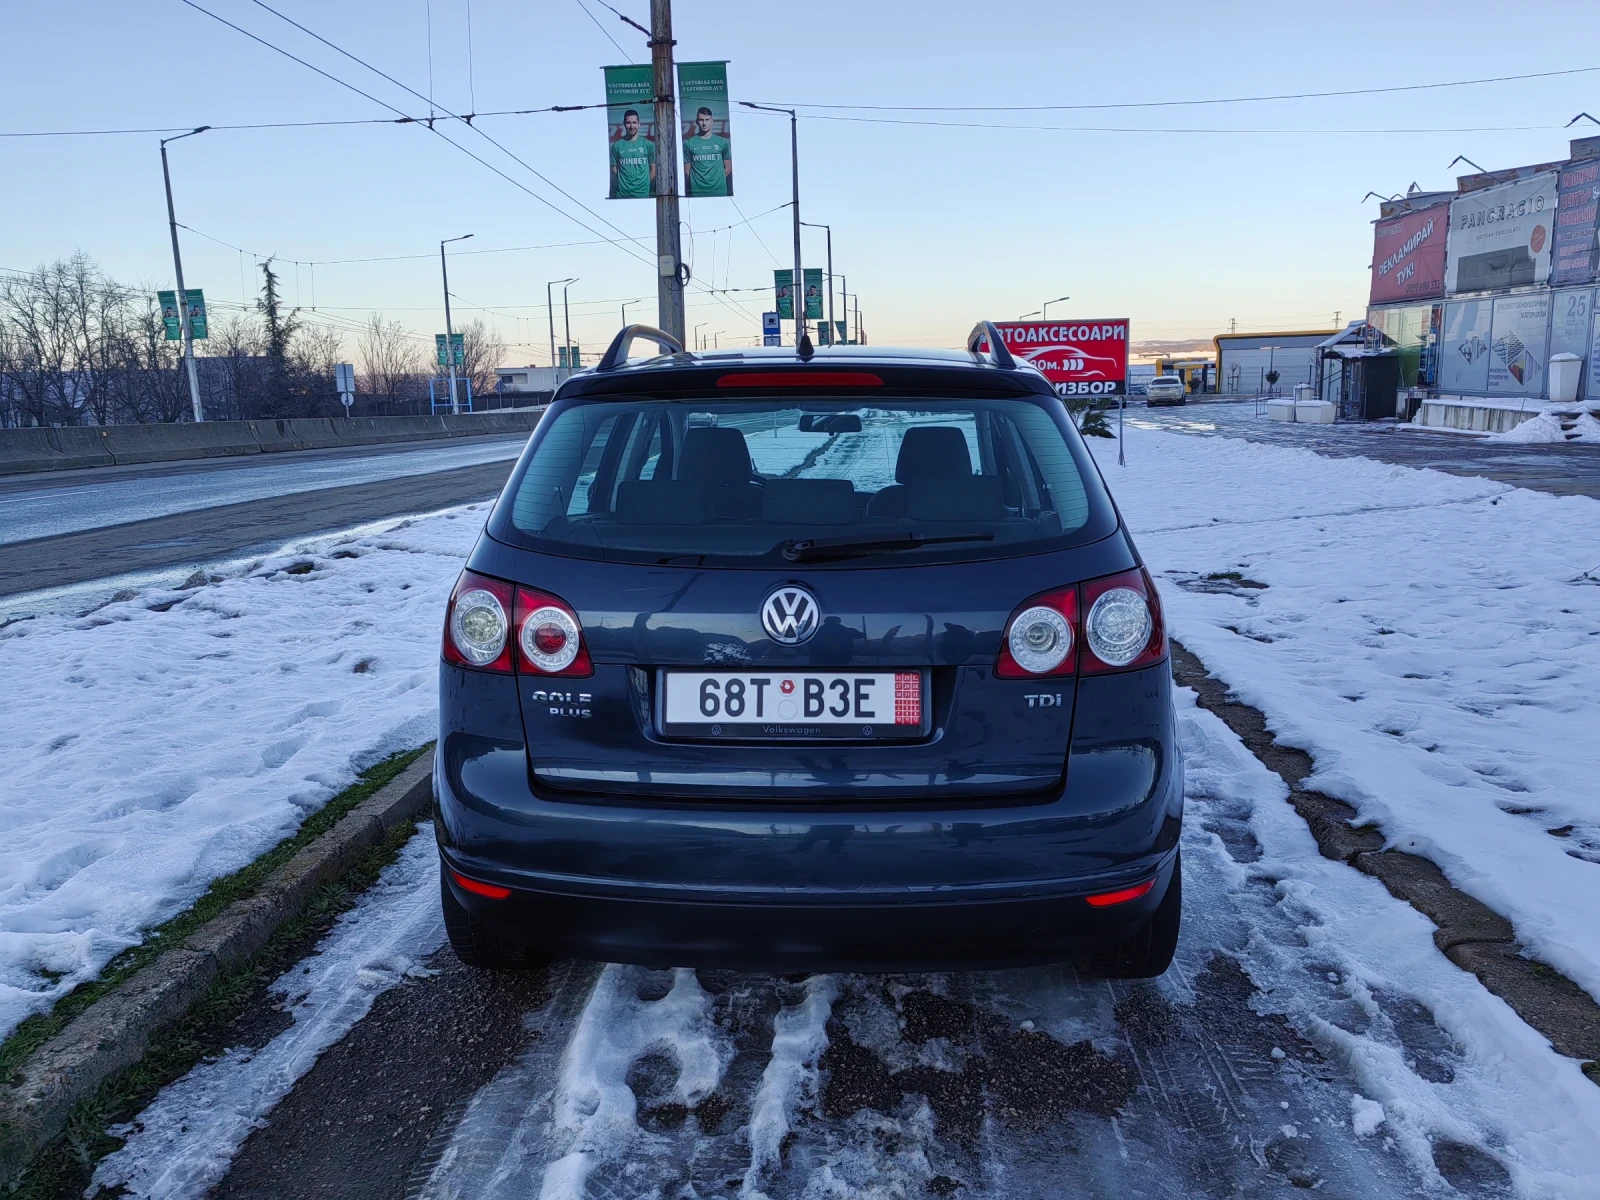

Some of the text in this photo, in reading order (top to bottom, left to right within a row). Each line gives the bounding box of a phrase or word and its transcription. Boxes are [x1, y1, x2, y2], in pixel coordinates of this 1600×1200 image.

[620, 157, 647, 165] WINBET
[1460, 196, 1545, 230] PANCRACIO
[1378, 217, 1434, 278] РЕКЛАМИРАЙ
[1396, 261, 1414, 286] ТУК!
[1567, 295, 1587, 317] 25
[1055, 381, 1117, 395] ИЗБОР
[532, 690, 592, 706] GOLF
[700, 678, 876, 718] 68T B3E
[549, 707, 592, 718] PLUS
[762, 725, 821, 735] Volkswagen
